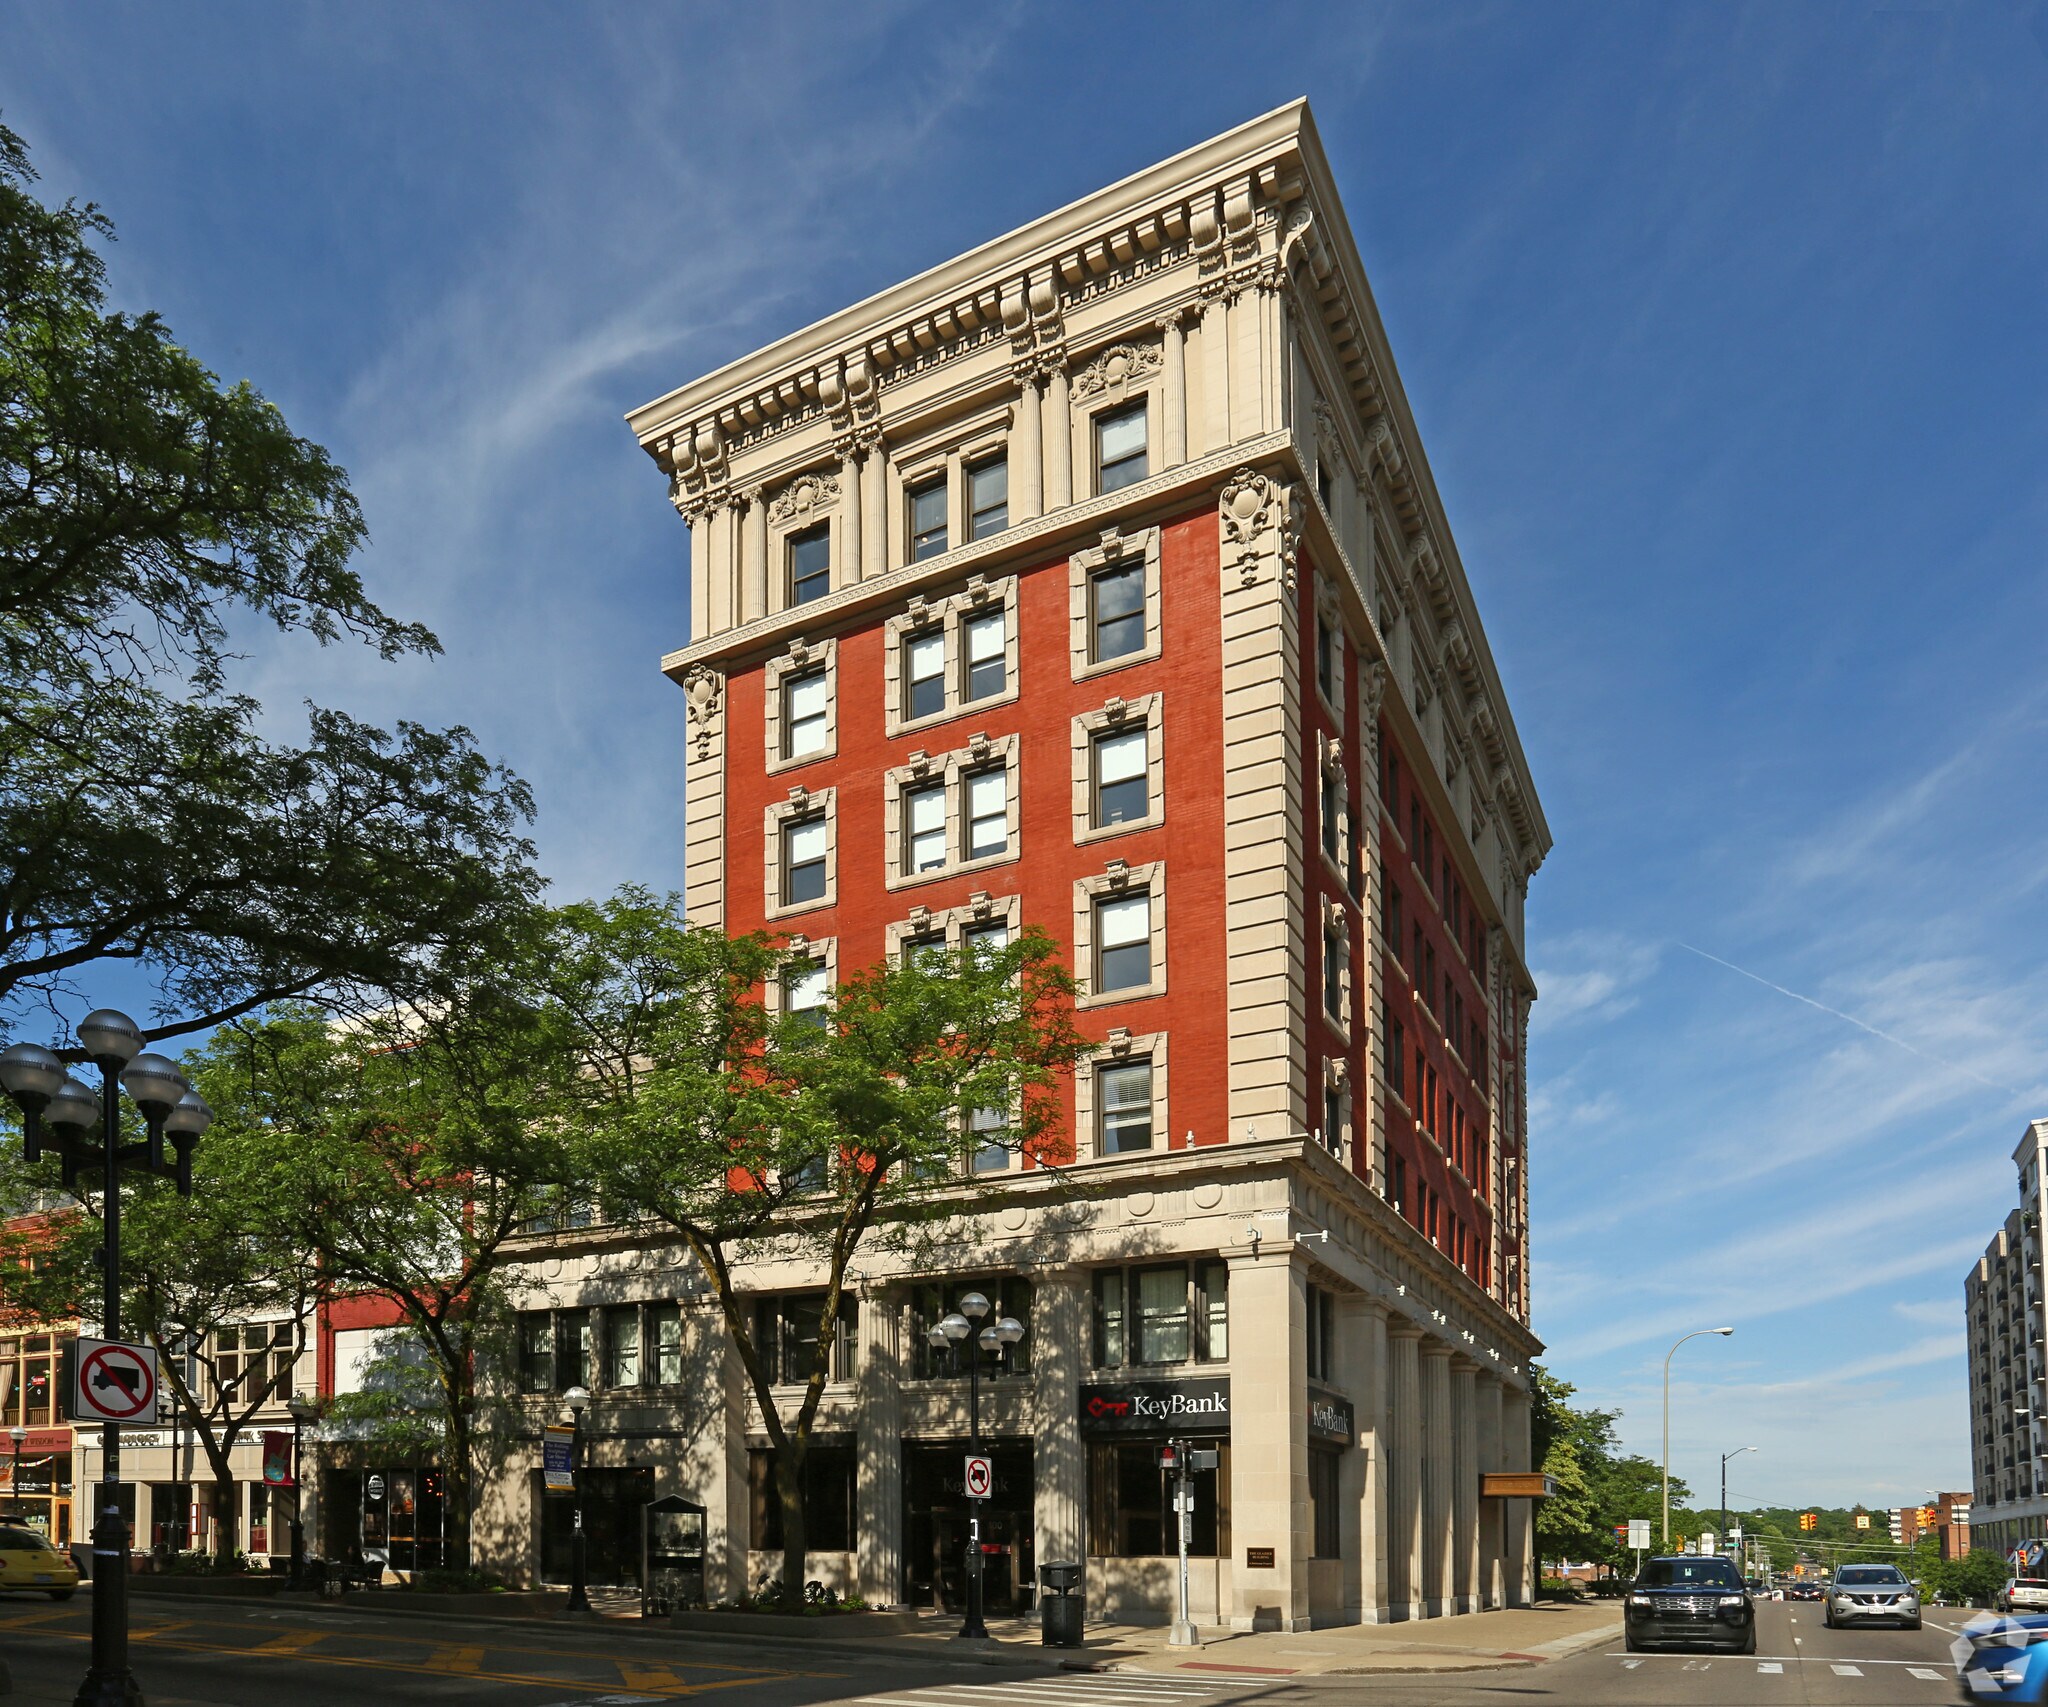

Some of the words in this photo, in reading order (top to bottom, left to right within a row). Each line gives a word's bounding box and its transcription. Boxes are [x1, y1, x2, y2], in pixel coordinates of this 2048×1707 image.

[1133, 1392, 1228, 1420] KeyBank
[1312, 1401, 1349, 1436] KeyBank
[943, 1477, 1009, 1496] Keynk
